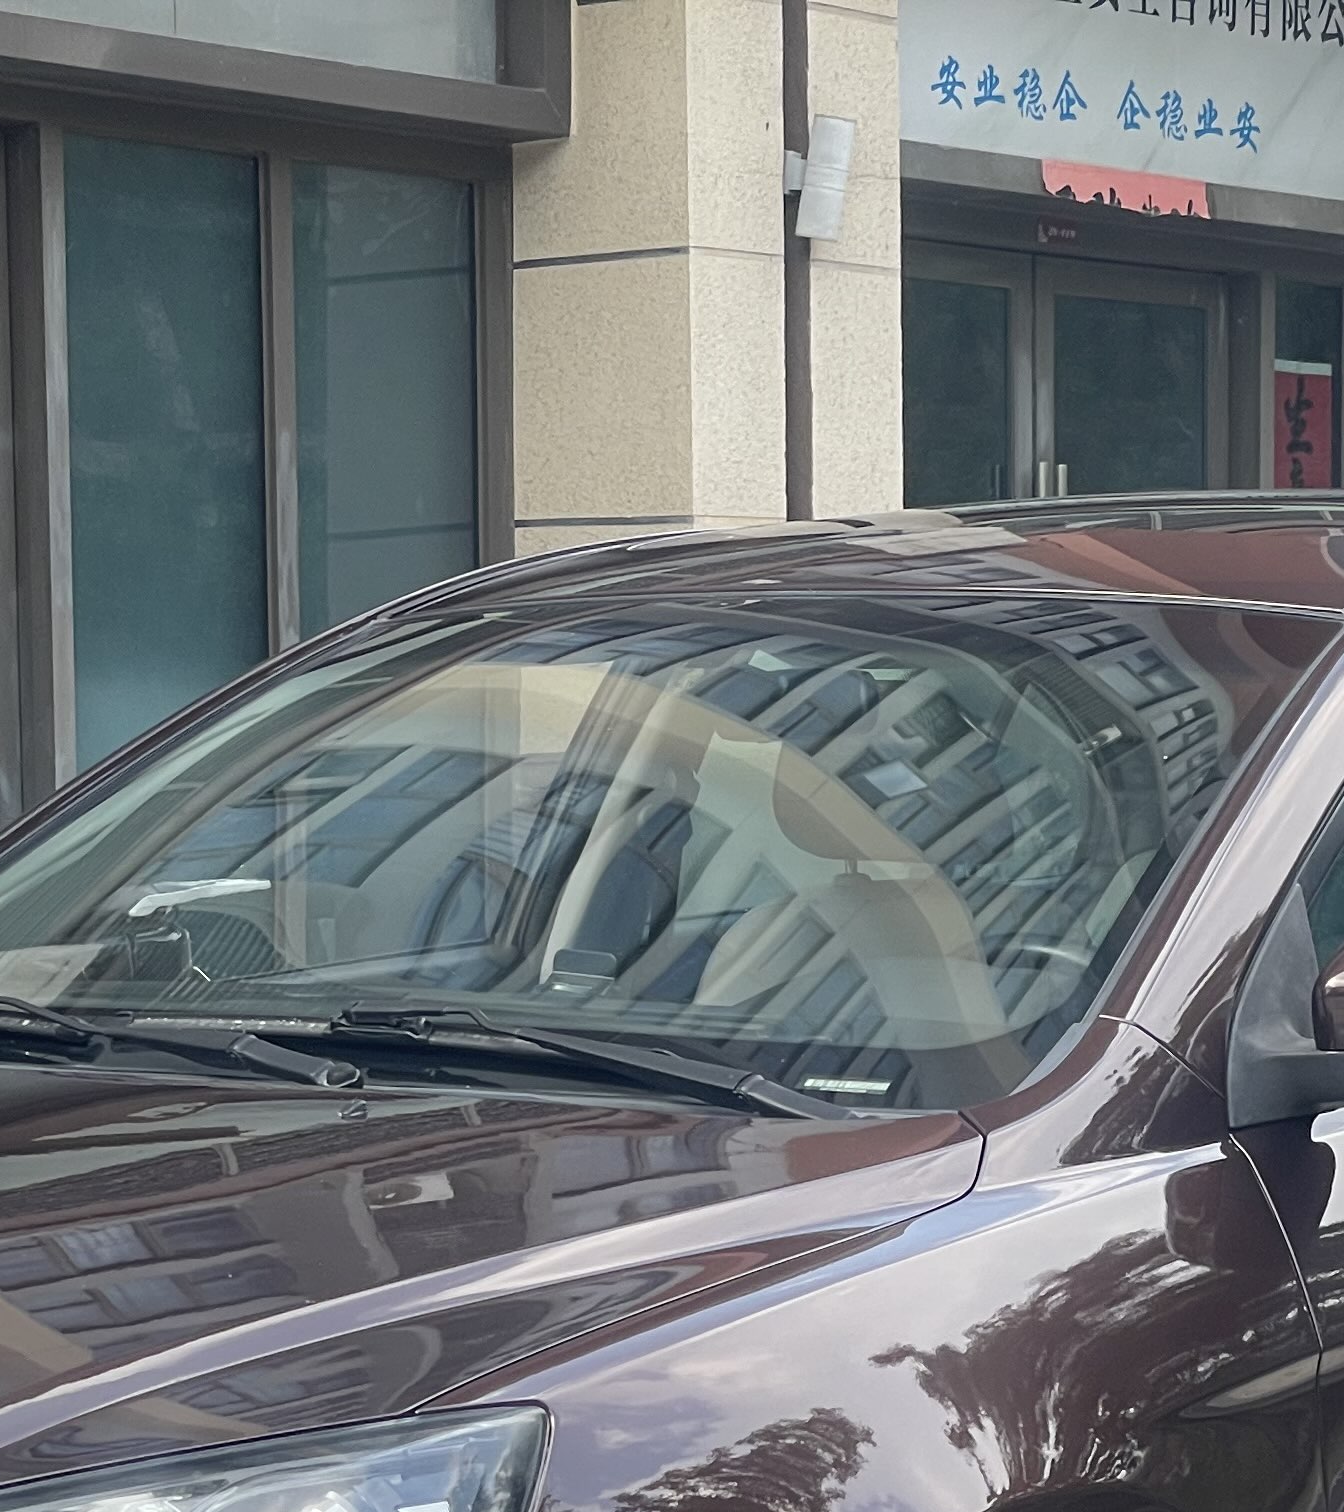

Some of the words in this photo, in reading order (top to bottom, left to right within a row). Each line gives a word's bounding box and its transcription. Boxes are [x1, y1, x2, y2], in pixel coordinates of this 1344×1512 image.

[931, 55, 1088, 123] 安业稳企
[1117, 79, 1261, 153] 企稳业安
